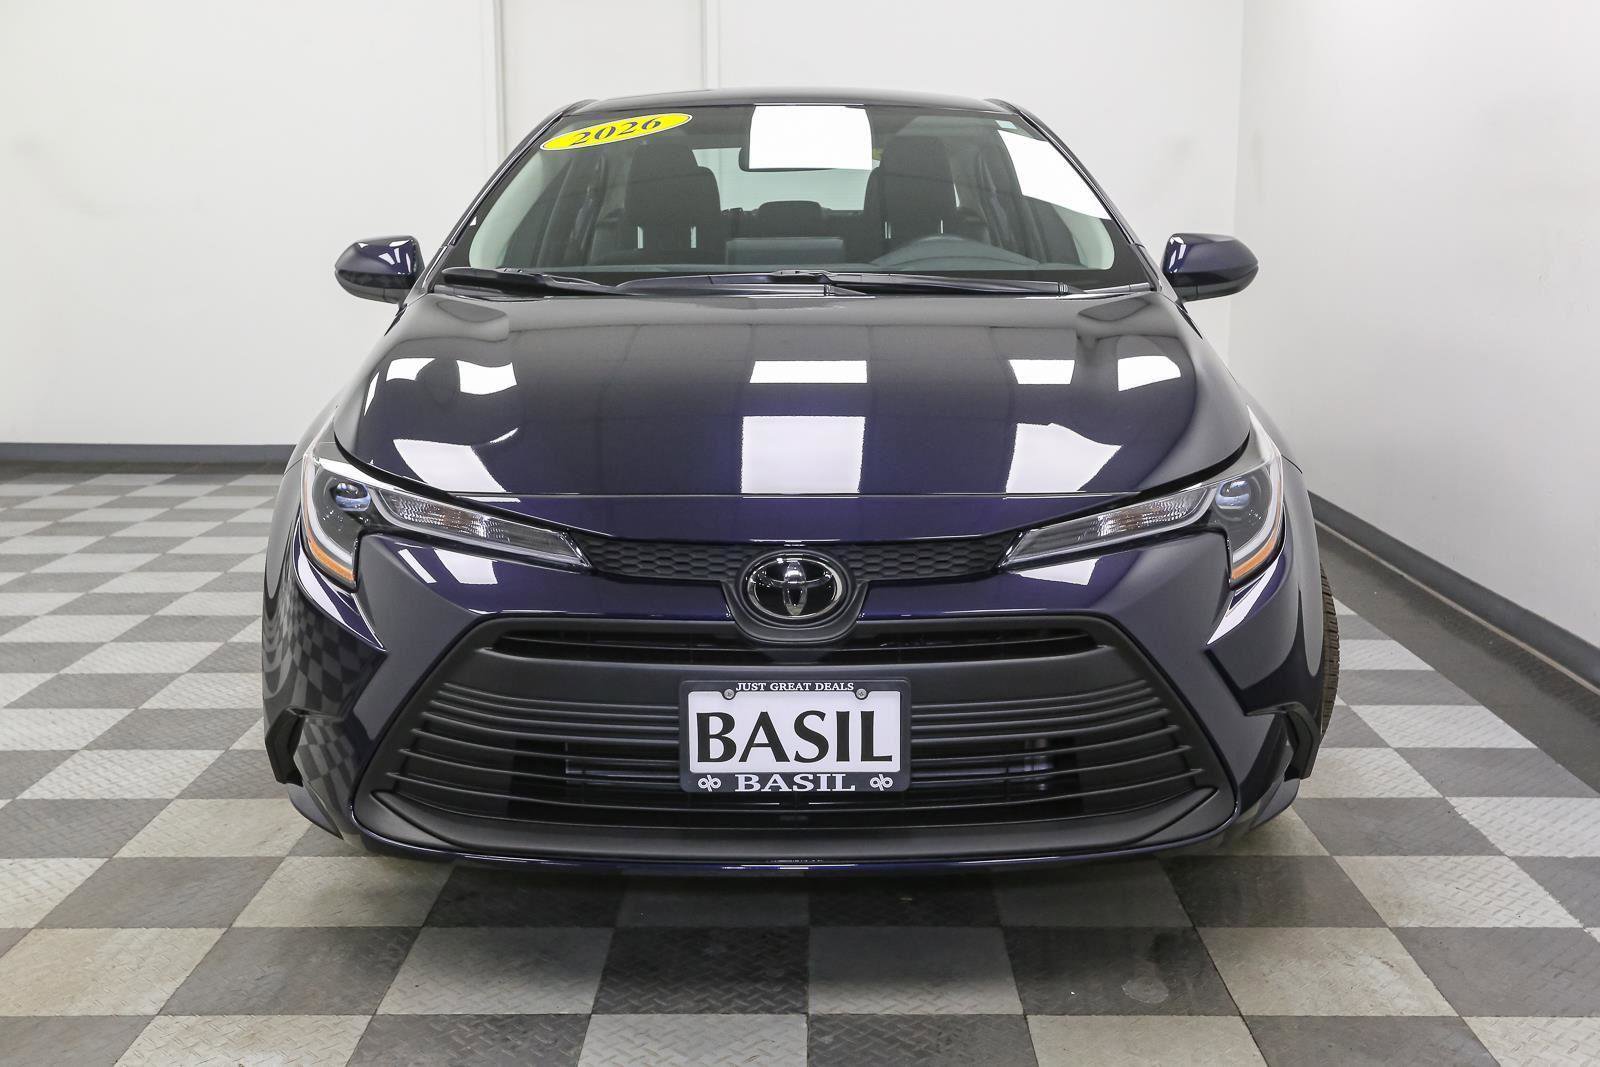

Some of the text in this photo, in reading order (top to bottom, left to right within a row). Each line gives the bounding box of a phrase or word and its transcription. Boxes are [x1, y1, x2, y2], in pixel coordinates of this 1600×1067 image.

[569, 117, 662, 147] 2026
[735, 682, 855, 692] JUST GREAT DEALS
[696, 710, 893, 764] BASIL
[734, 774, 856, 792] BASIL
